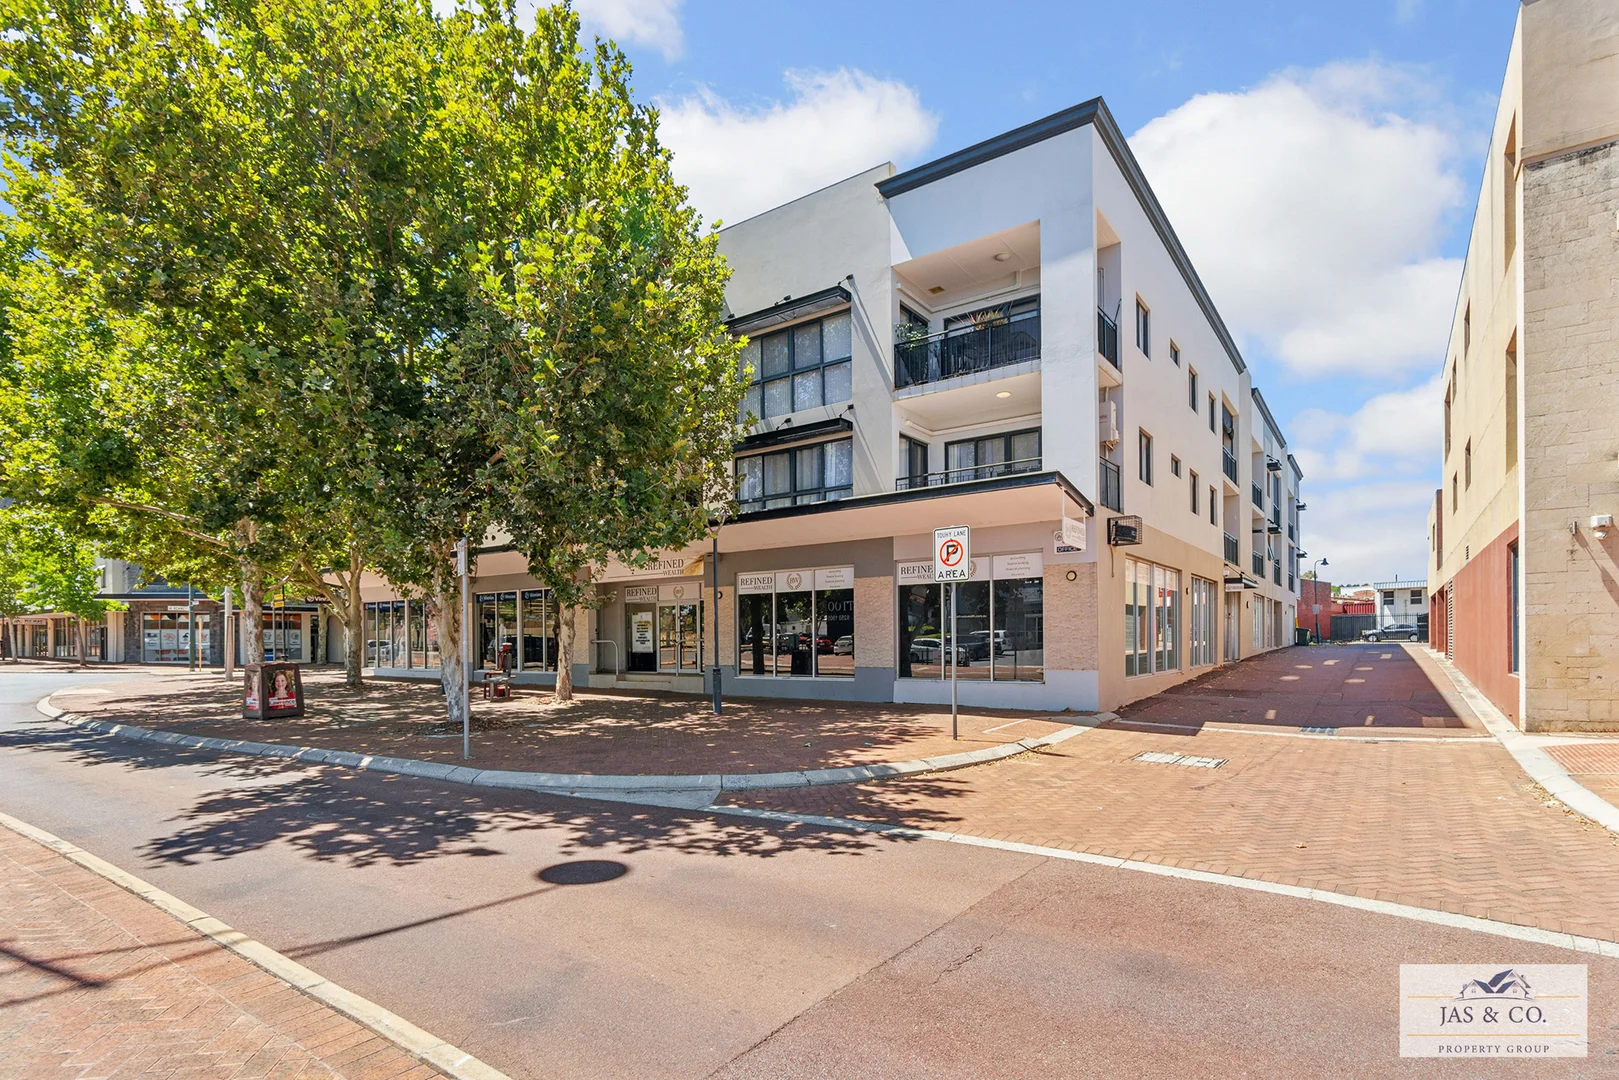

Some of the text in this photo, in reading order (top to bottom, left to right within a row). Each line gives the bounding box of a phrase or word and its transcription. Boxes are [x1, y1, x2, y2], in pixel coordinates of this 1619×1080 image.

[954, 529, 966, 537] LANE
[647, 558, 684, 571] REFINED
[900, 564, 934, 575] REFINE
[937, 569, 966, 580] AREA
[740, 576, 773, 586] REFINED
[626, 587, 657, 597] REFINED
